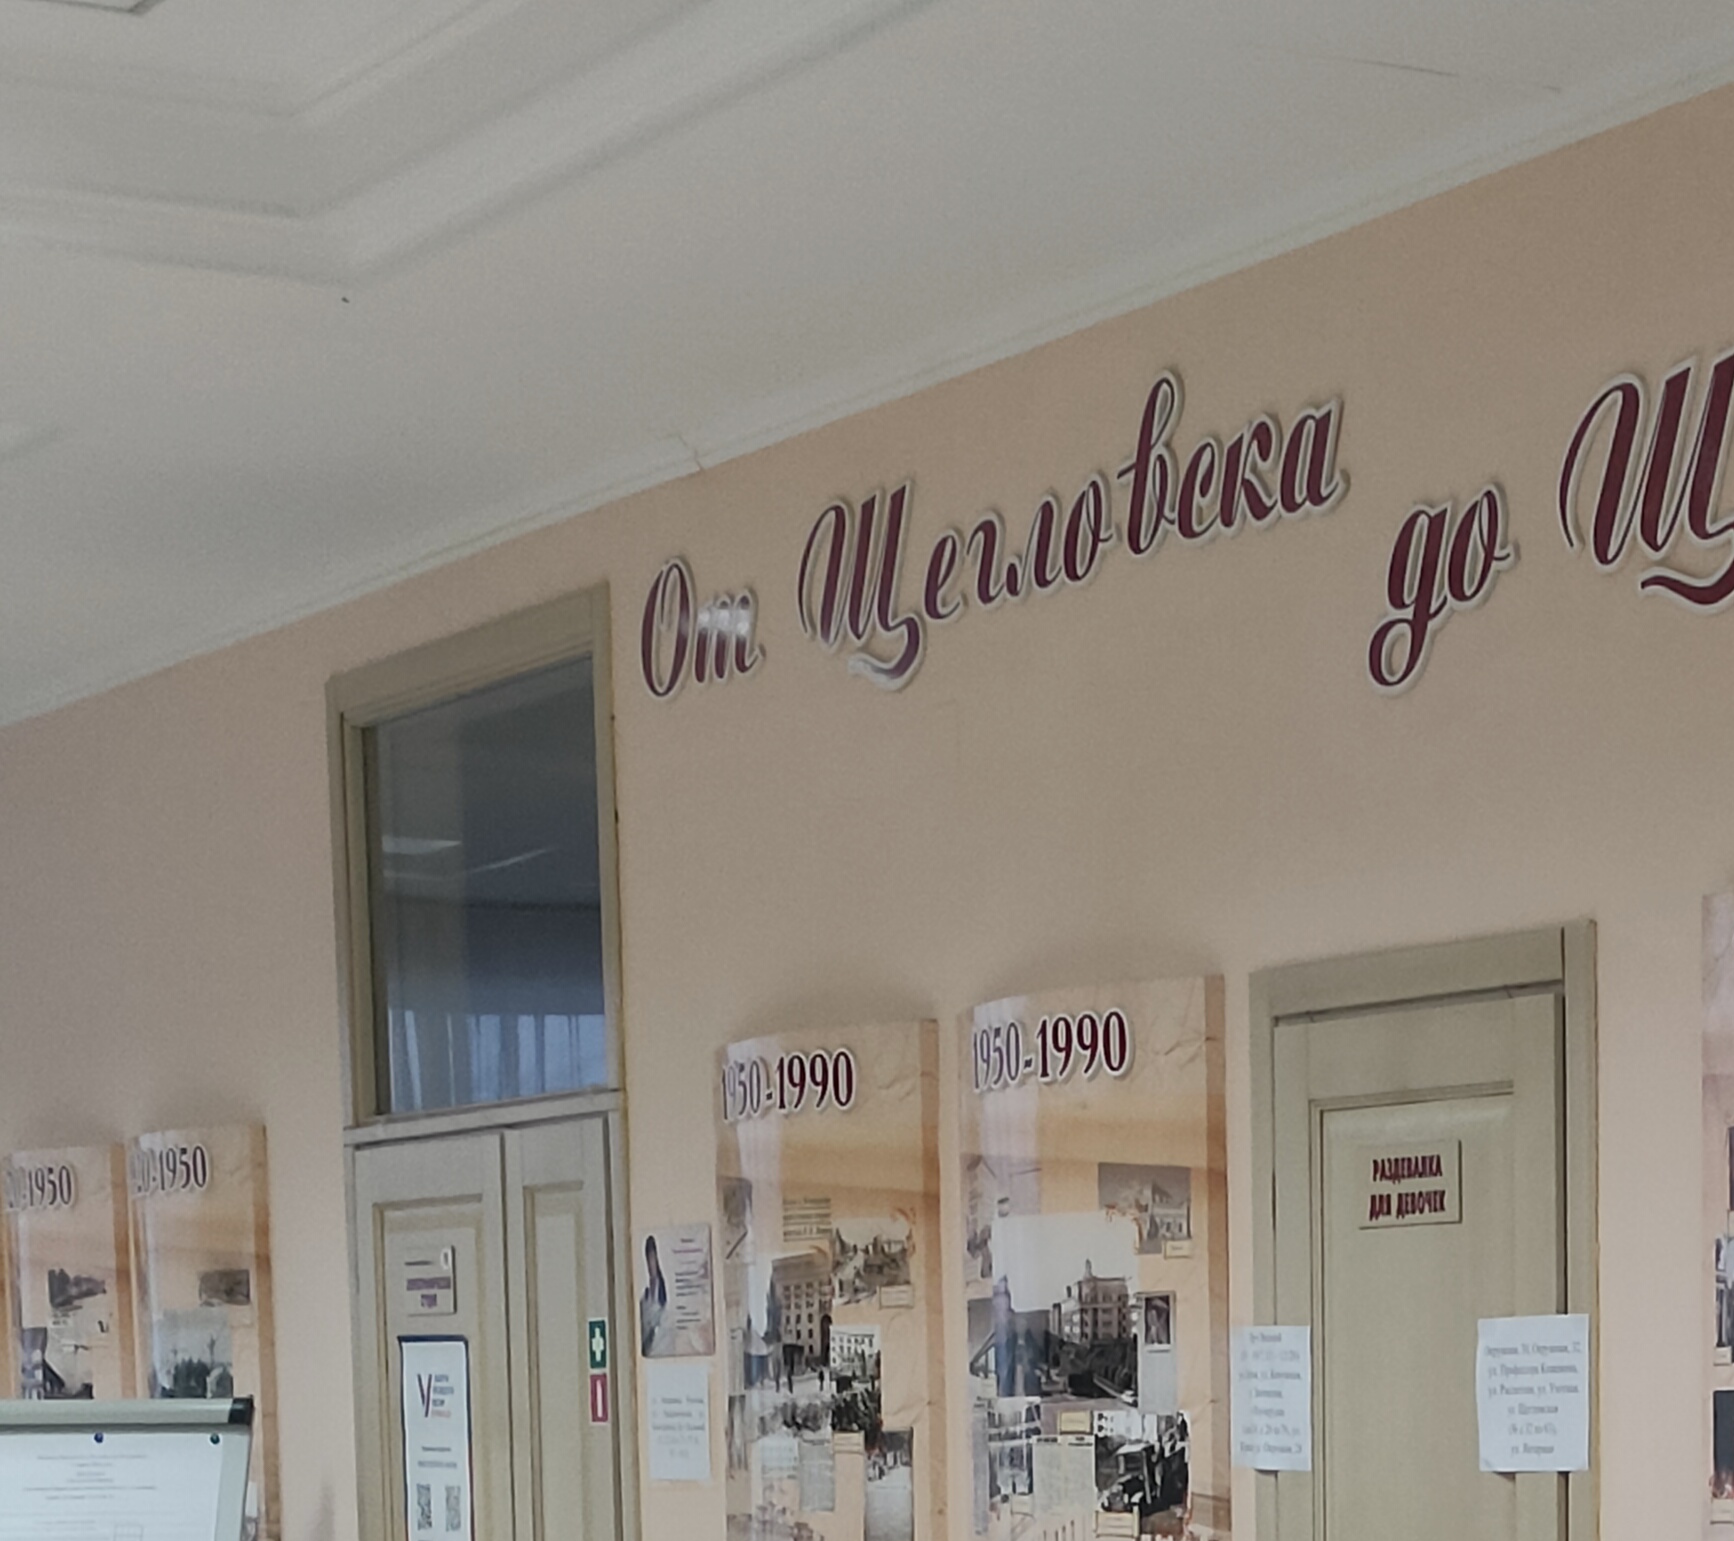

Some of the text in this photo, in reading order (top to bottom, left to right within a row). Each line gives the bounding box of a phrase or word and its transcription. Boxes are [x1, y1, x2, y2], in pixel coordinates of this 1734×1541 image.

[641, 557, 765, 697] От
[799, 371, 1348, 688] Щегловска
[1368, 485, 1514, 690] до
[722, 1050, 854, 1121] 1950-1990
[973, 1011, 1128, 1090] 1950-1990
[1368, 1189, 1446, 1221] ДЛЯ ДЕВОЧЕК
[1372, 1154, 1443, 1185] РАЗДЕВАЛКА
